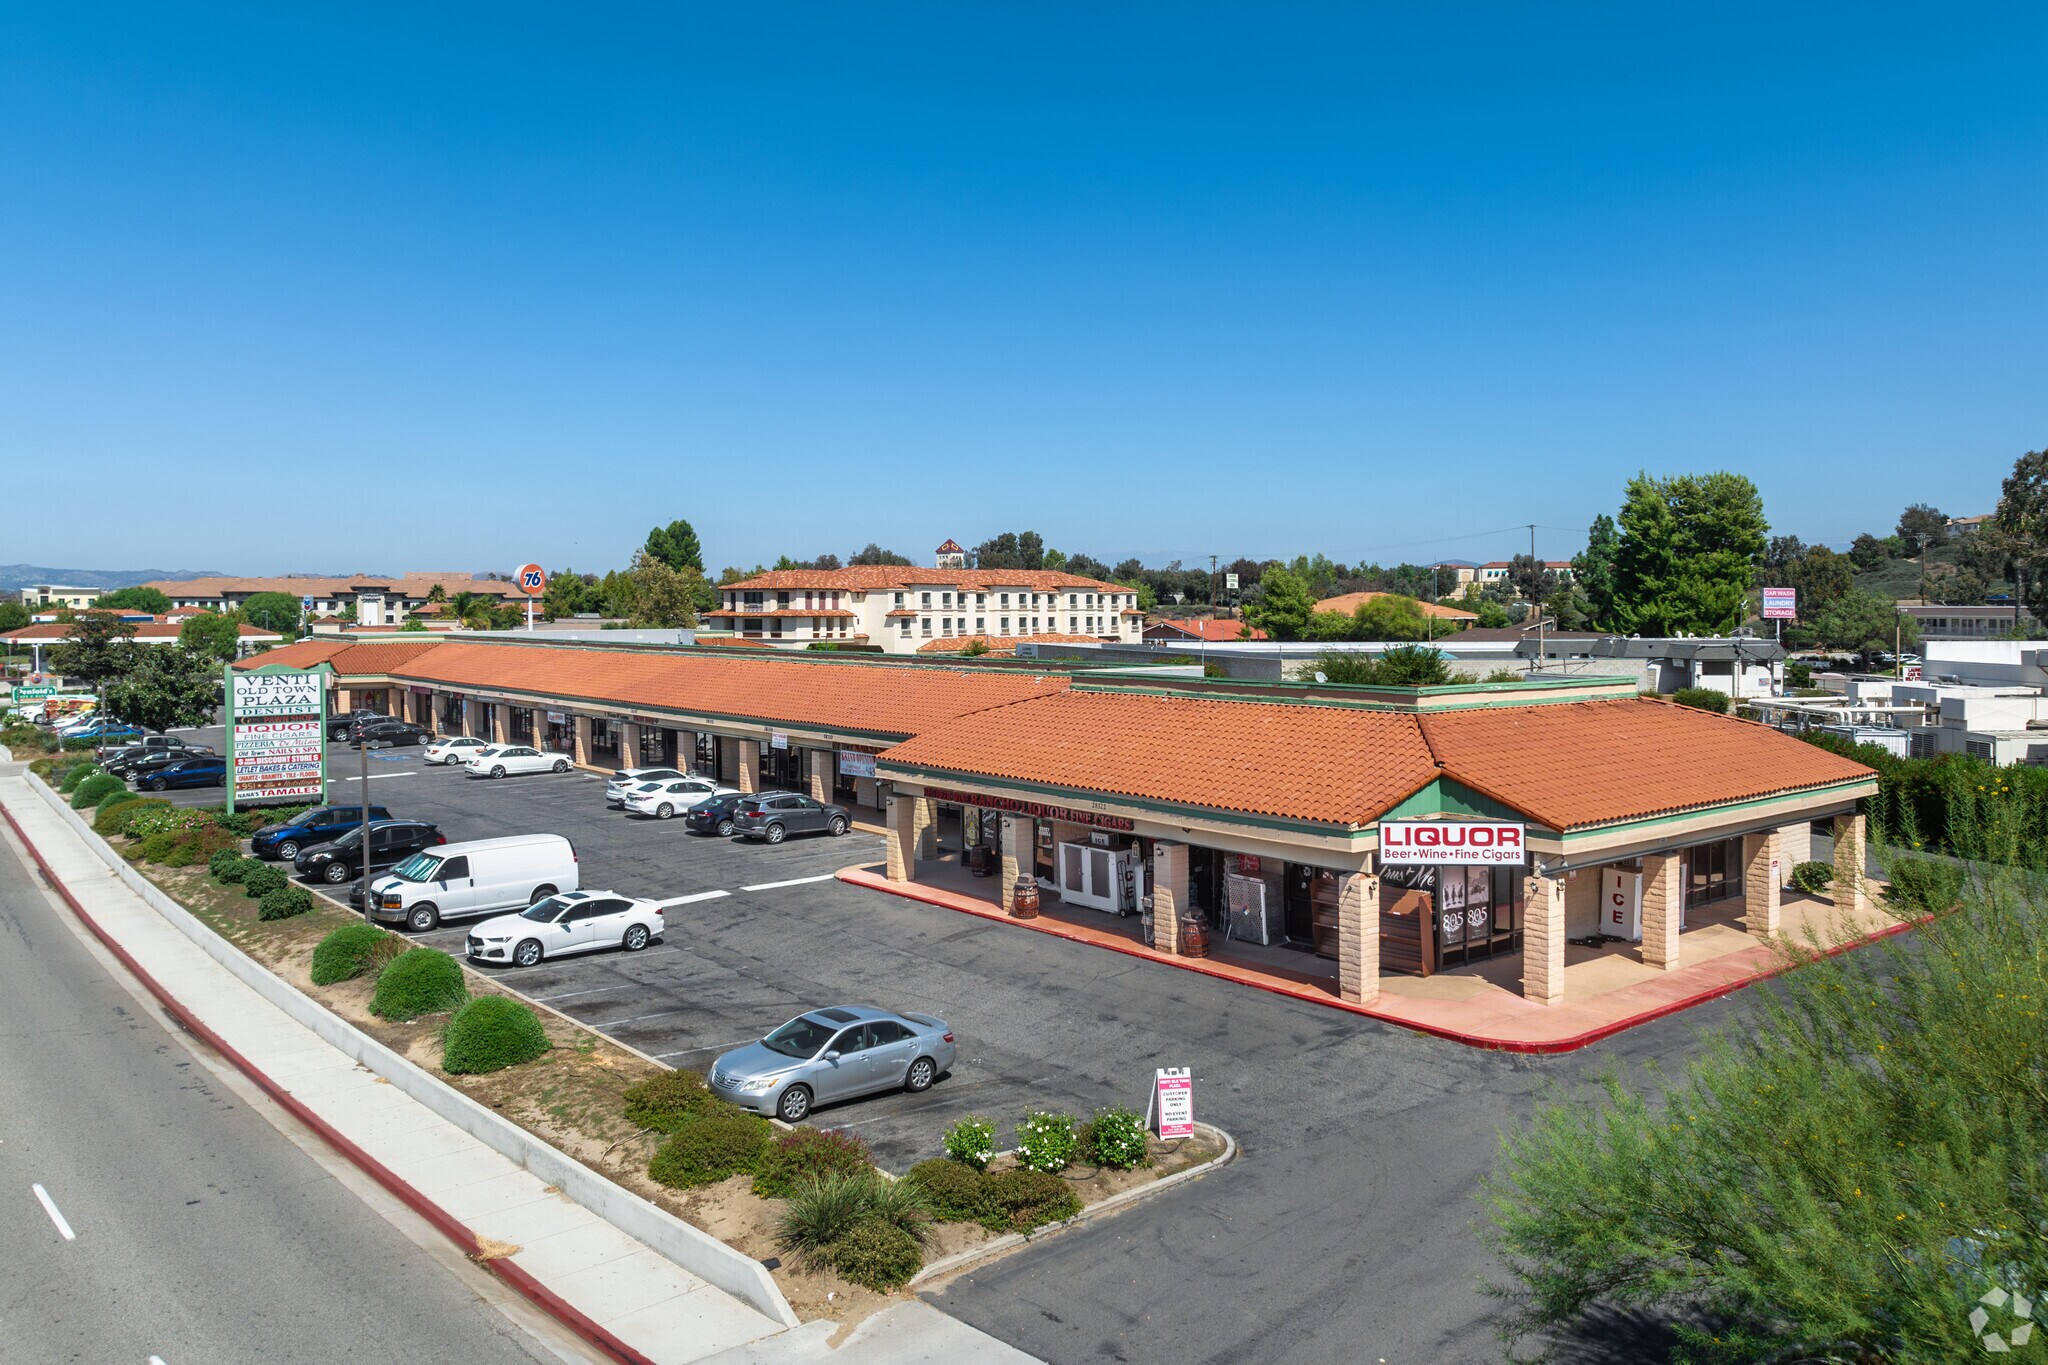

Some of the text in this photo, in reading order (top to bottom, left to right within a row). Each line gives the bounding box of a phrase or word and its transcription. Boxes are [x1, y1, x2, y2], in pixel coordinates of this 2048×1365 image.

[524, 571, 542, 587] 76
[244, 674, 311, 686] VENTI
[273, 686, 317, 694] TOWN
[242, 695, 312, 706] PLAZA
[242, 706, 314, 715] DENTIST
[236, 723, 319, 733] LIQUOR
[256, 756, 290, 764] DISCOUNT
[288, 762, 320, 770] CATERING
[260, 786, 318, 796] TAMALES
[970, 793, 1019, 812] RANCHO
[1021, 801, 1068, 821] LIQUOR
[1070, 810, 1091, 824] FINE
[1093, 814, 1131, 831] CIGARS
[1384, 826, 1520, 847] LIQUOR
[1385, 849, 1520, 861] Beer Wine Fine Cigars
[1125, 854, 1133, 898] ICE
[1612, 876, 1624, 924] ICE
[1443, 912, 1463, 929] 805
[1468, 907, 1487, 924] 805
